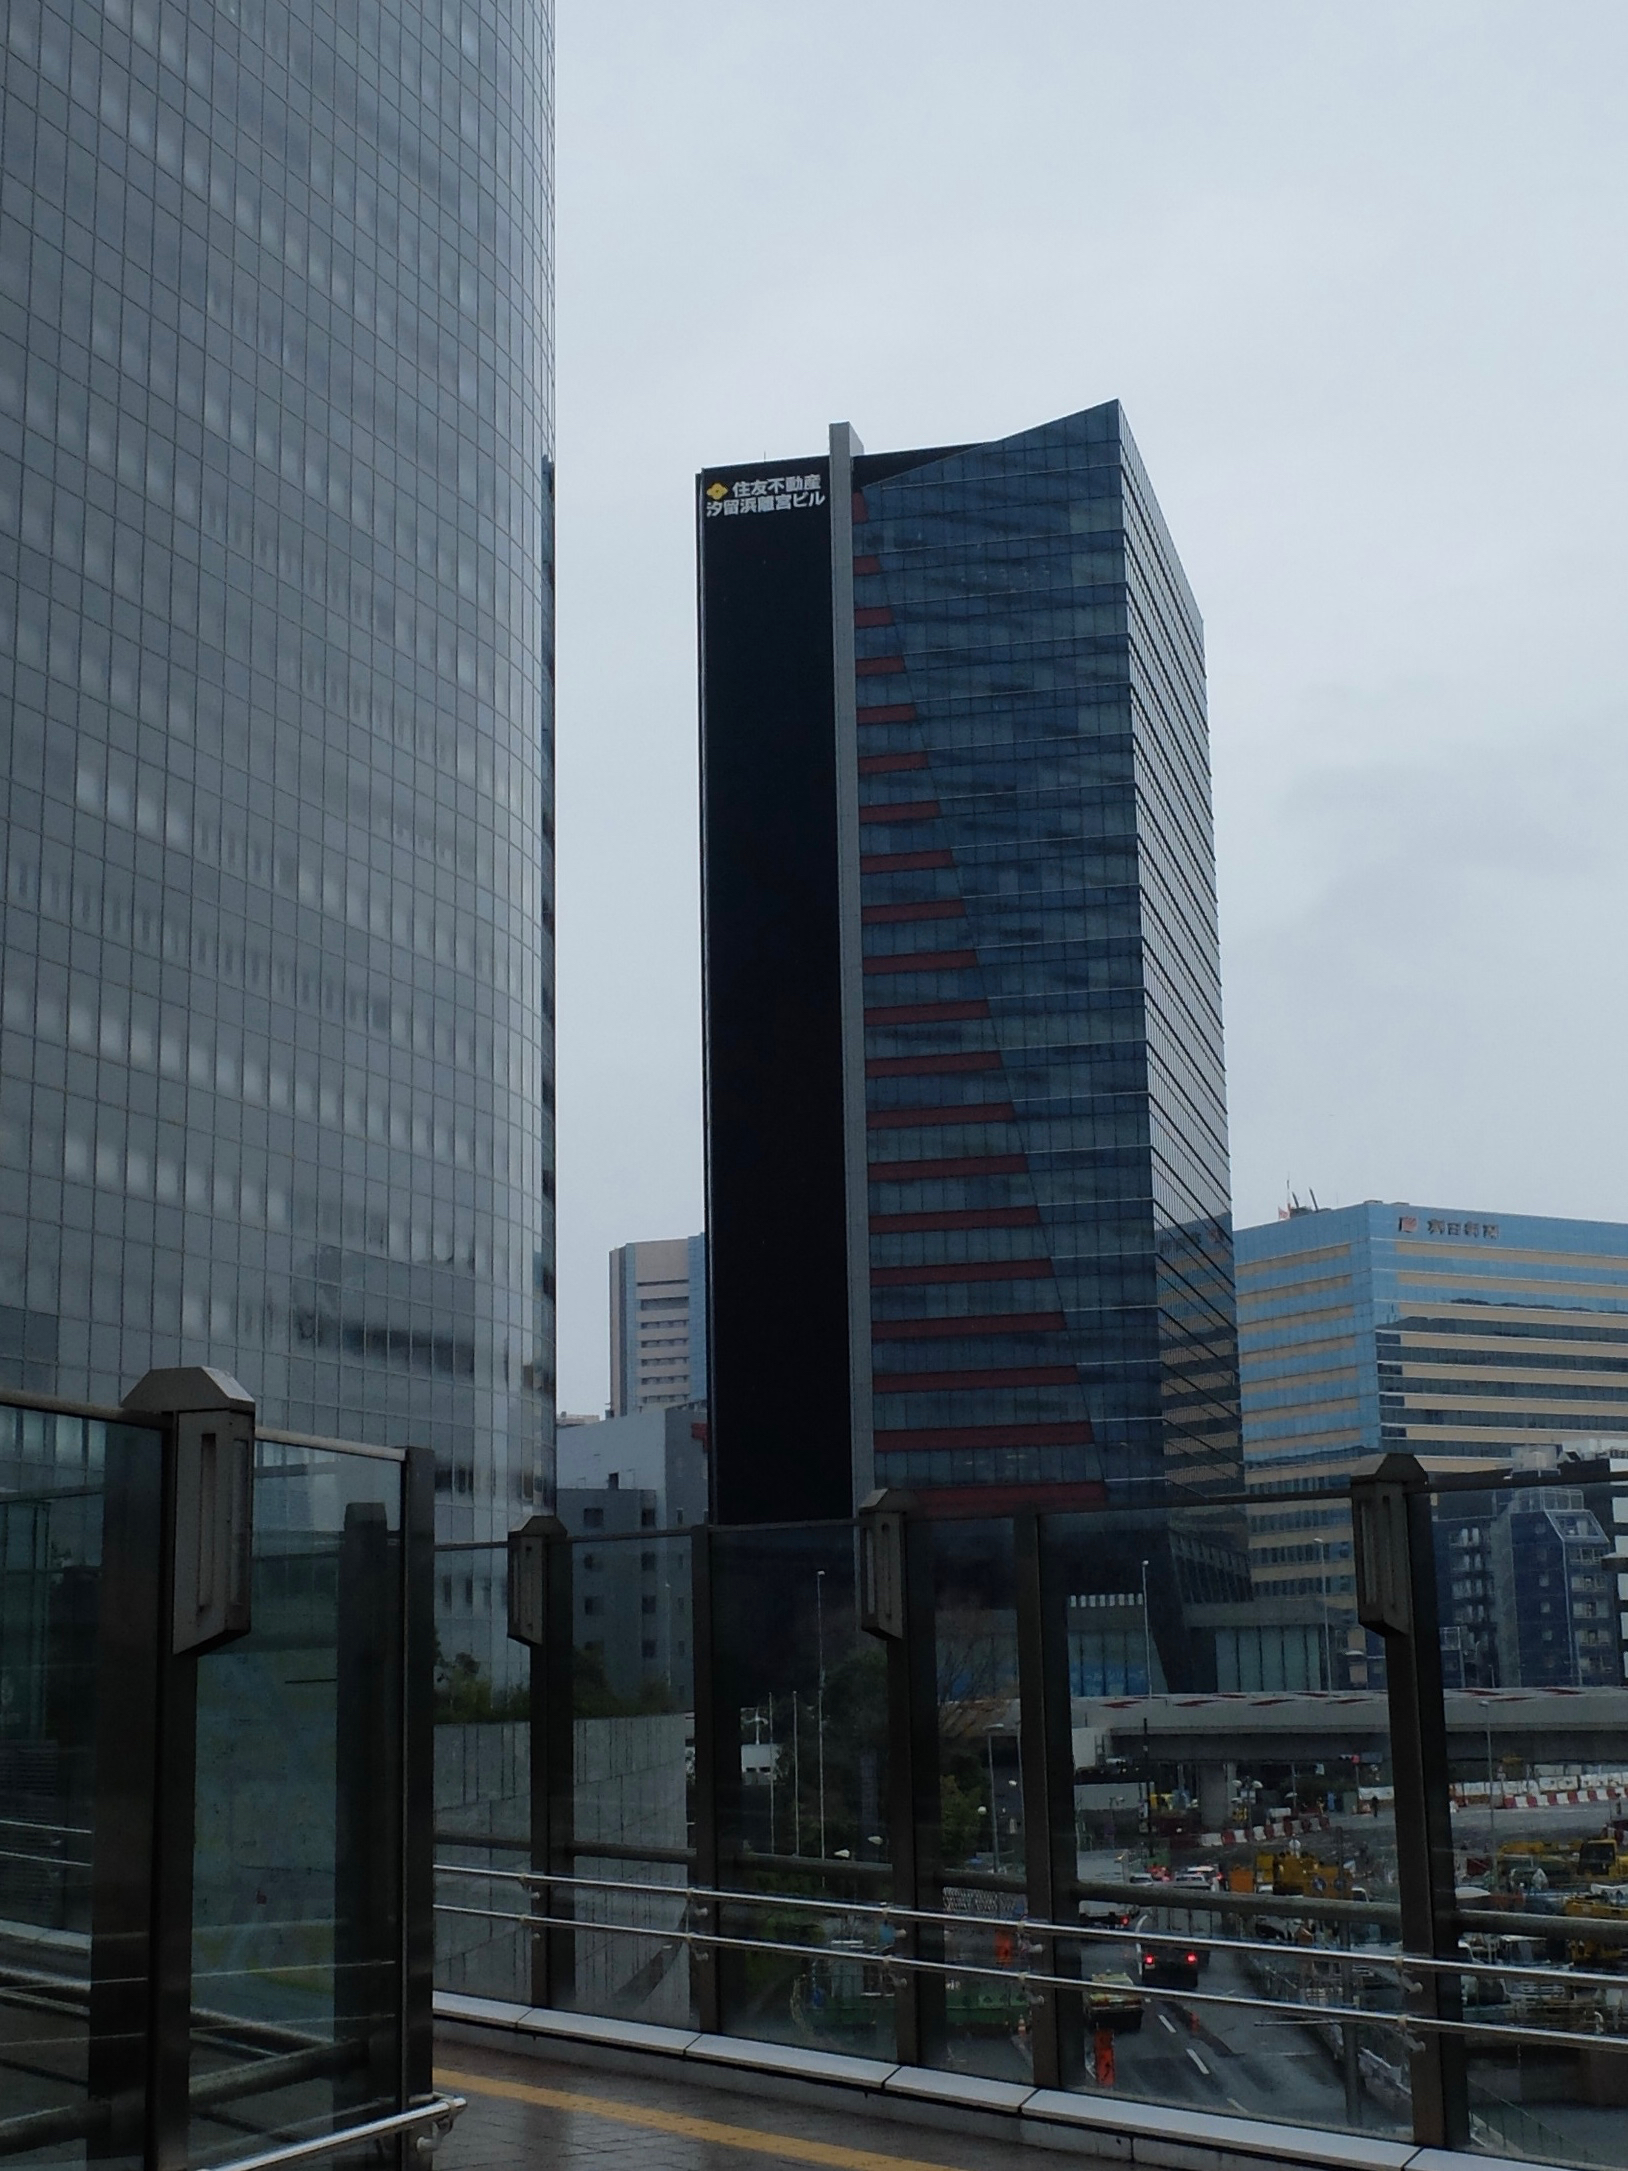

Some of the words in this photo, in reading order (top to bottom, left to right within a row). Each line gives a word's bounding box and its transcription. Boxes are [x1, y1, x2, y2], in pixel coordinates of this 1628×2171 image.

[732, 474, 821, 498] 住友不動産
